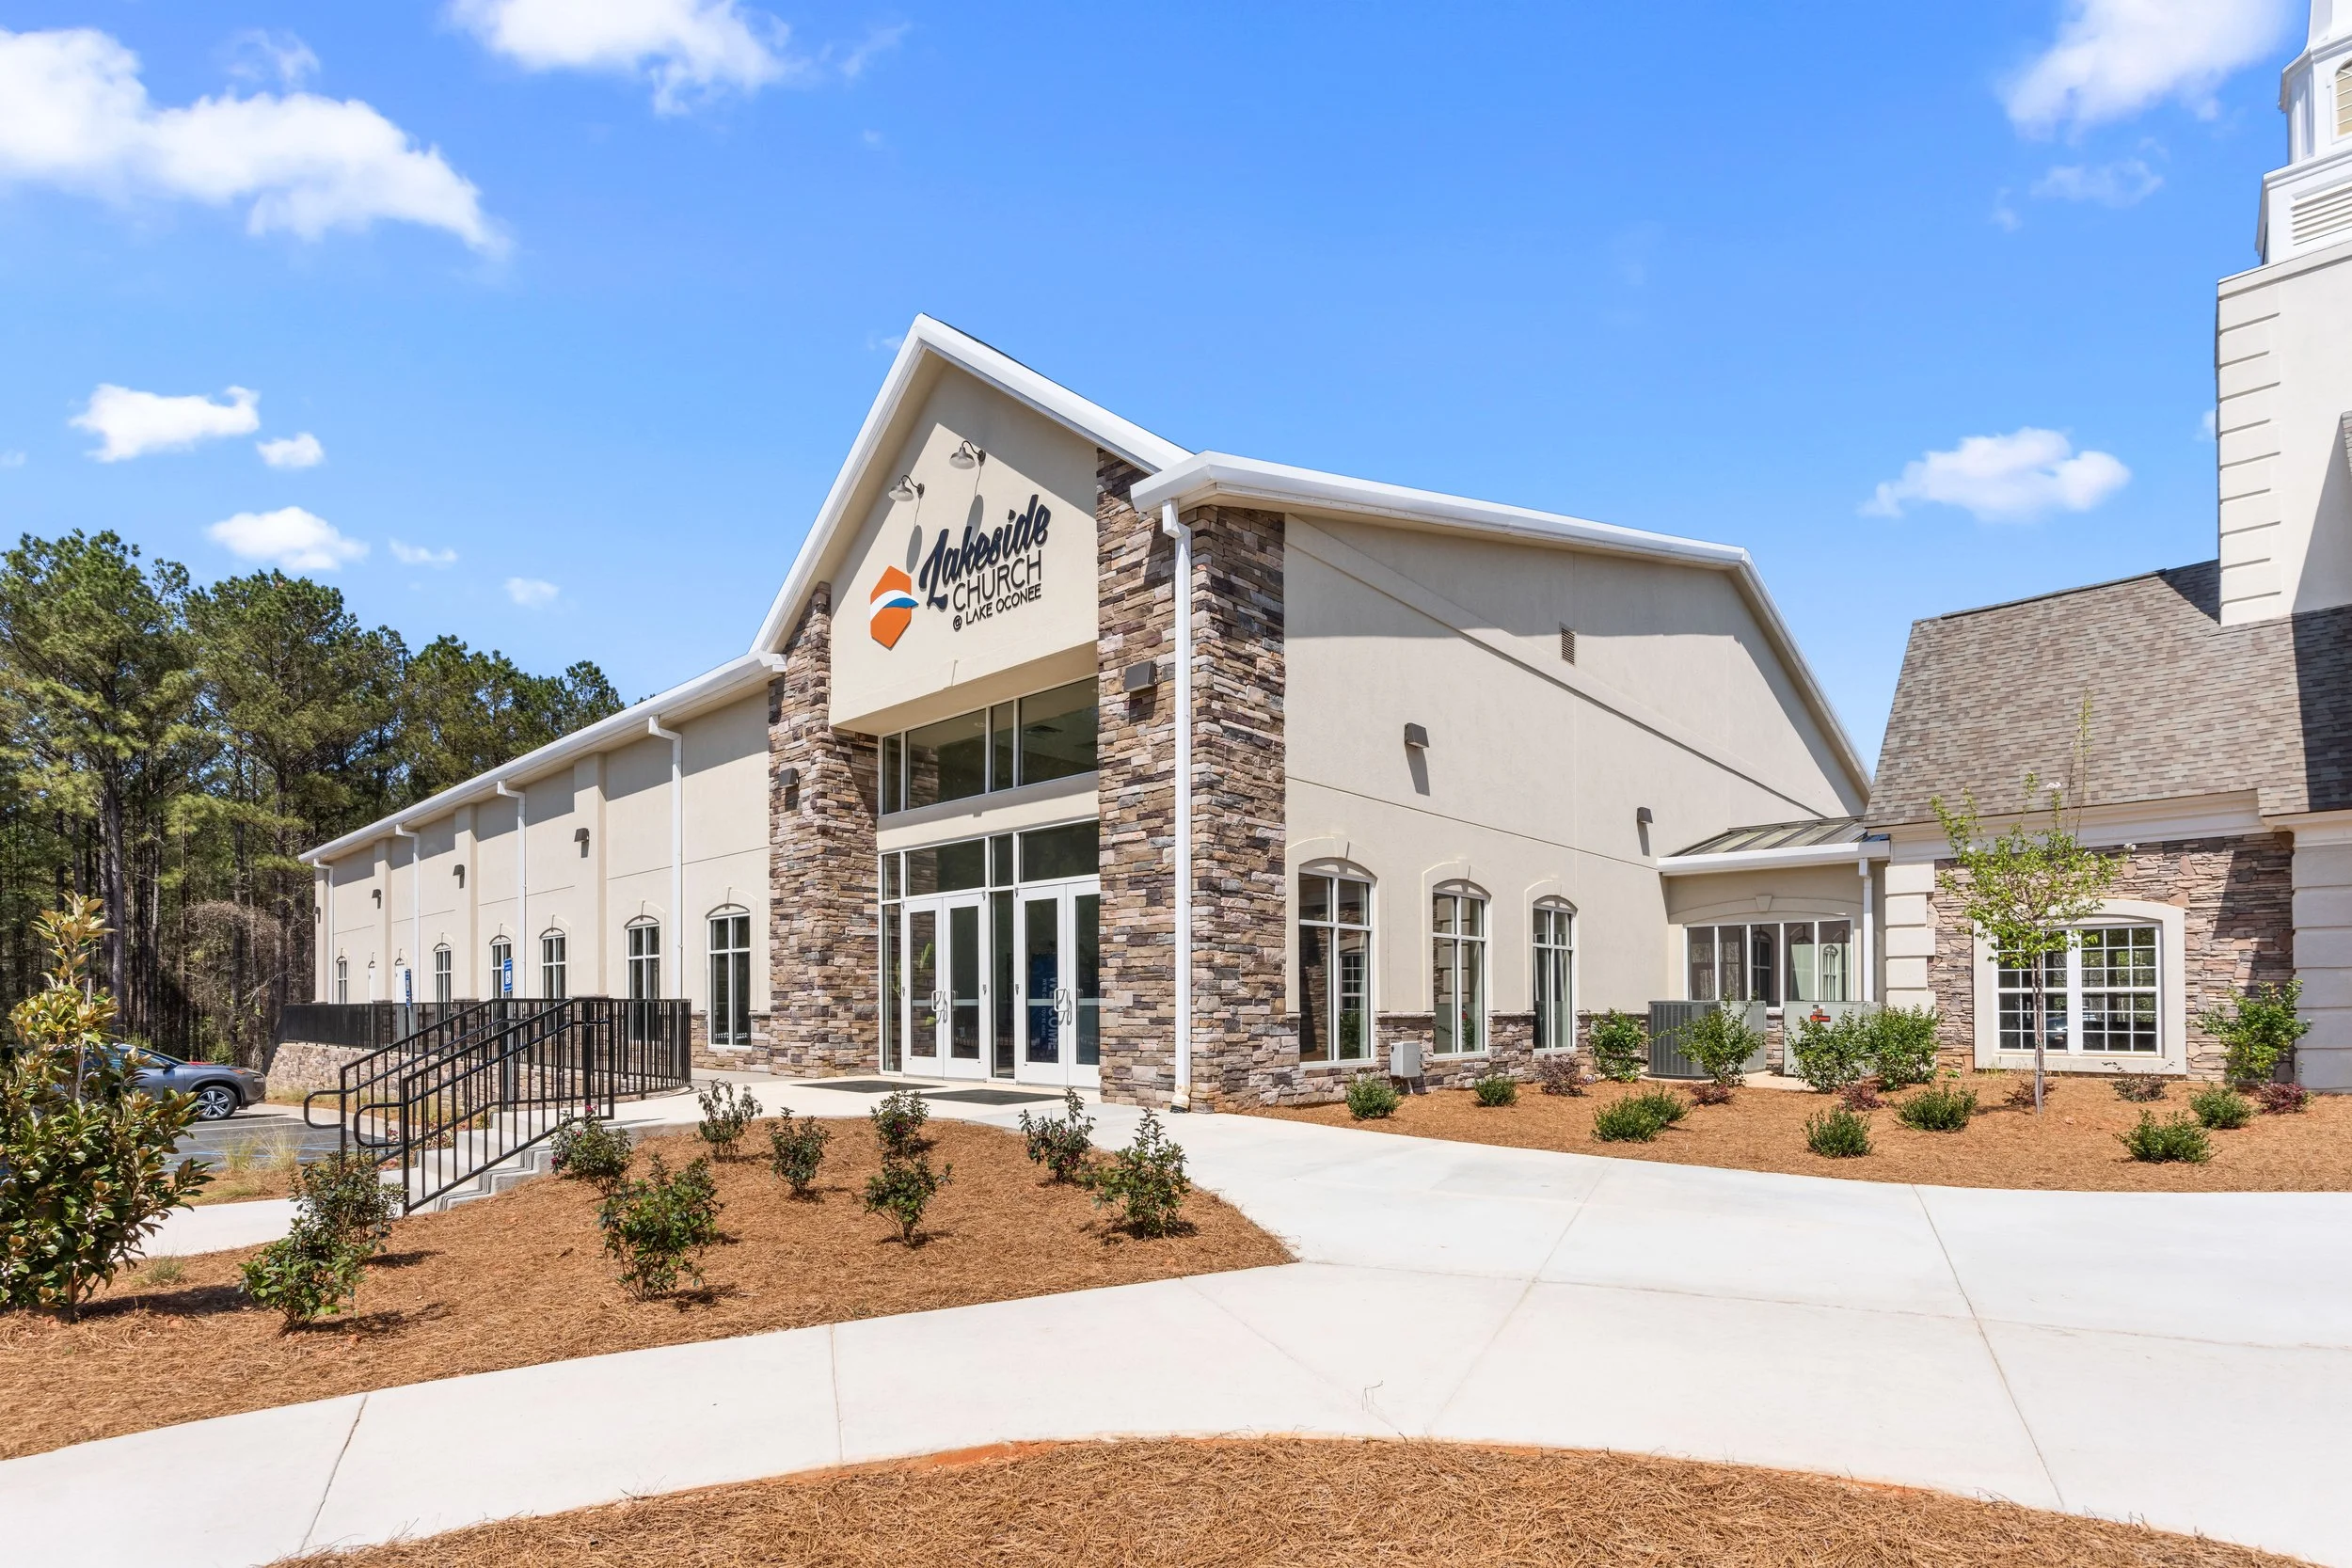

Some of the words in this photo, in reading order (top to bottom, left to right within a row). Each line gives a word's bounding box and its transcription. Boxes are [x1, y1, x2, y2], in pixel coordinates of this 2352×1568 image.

[918, 494, 1052, 610] Lakeside
[953, 549, 1041, 612] CHURCH
[953, 615, 962, 631] @
[965, 602, 993, 626] LAKE
[995, 583, 1041, 613] OCONEE
[1047, 976, 1058, 1051] WOME
